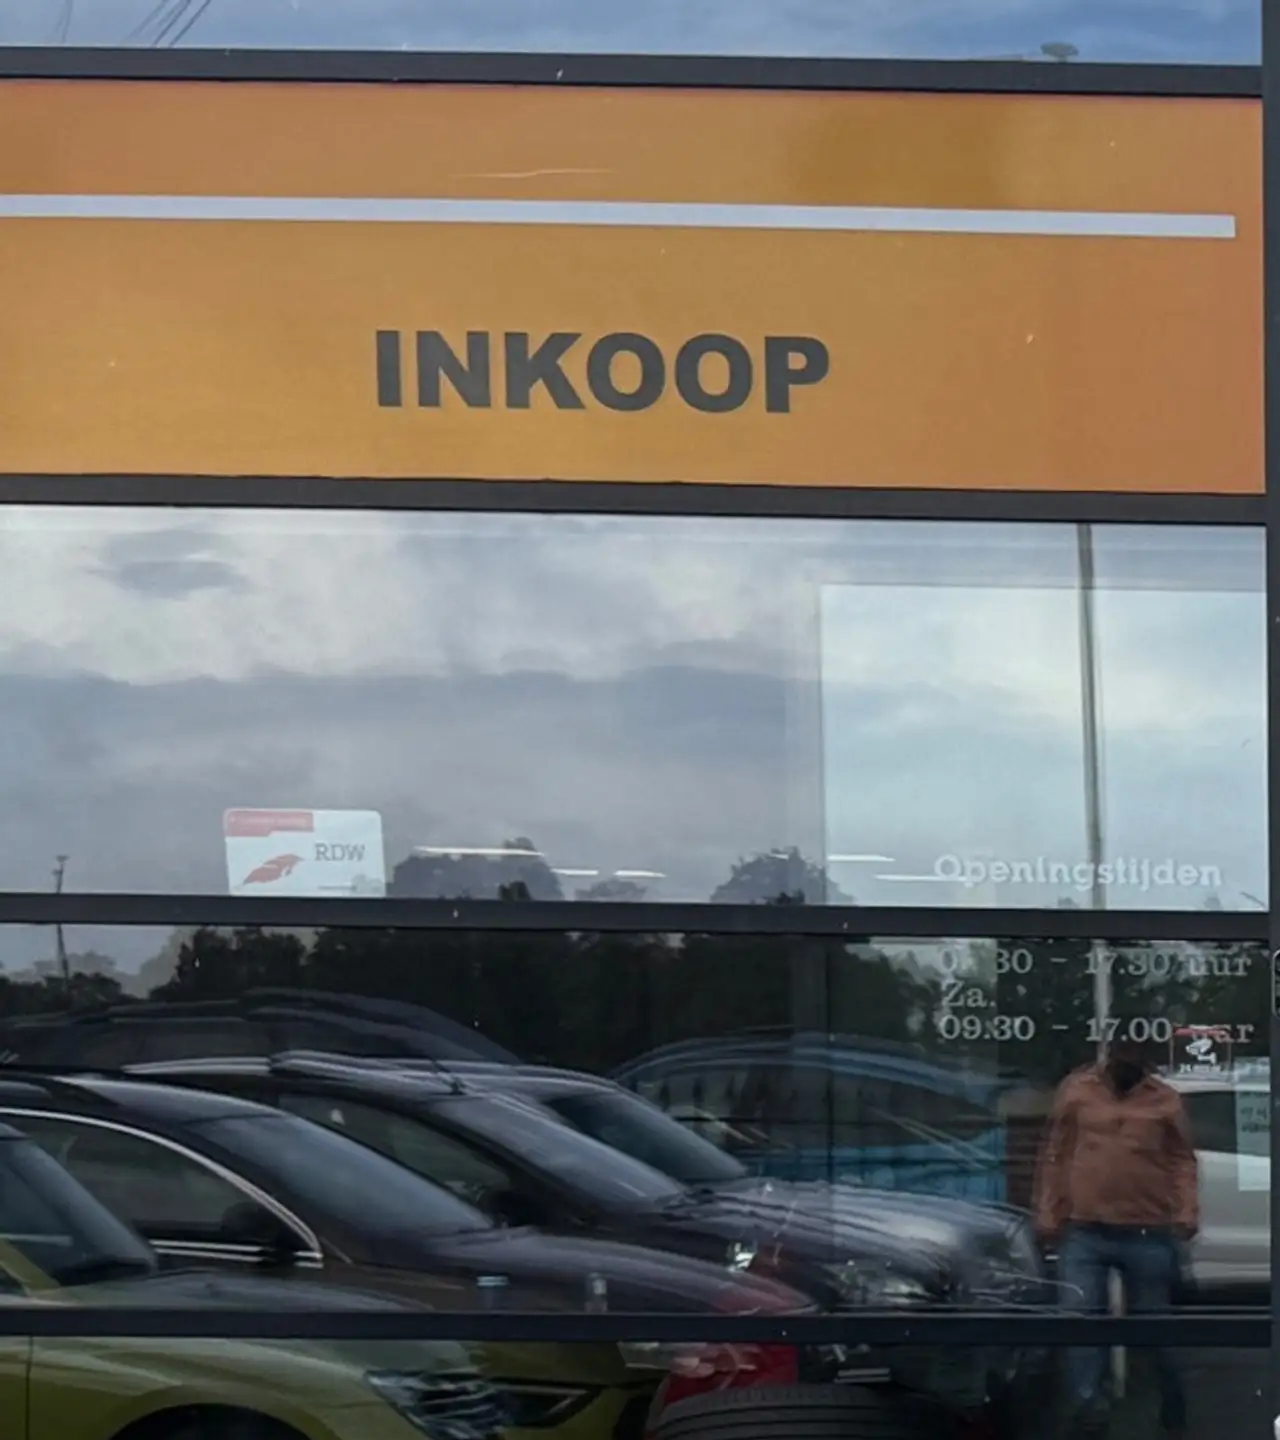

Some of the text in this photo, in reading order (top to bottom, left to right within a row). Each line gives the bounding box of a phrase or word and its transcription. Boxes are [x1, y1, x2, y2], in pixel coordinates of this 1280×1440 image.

[374, 329, 831, 414] INKOOP
[314, 843, 366, 862] RDW
[934, 854, 1223, 892] Openingstijden
[940, 1015, 1036, 1041] 09.30
[1085, 1017, 1172, 1042] 17.00
